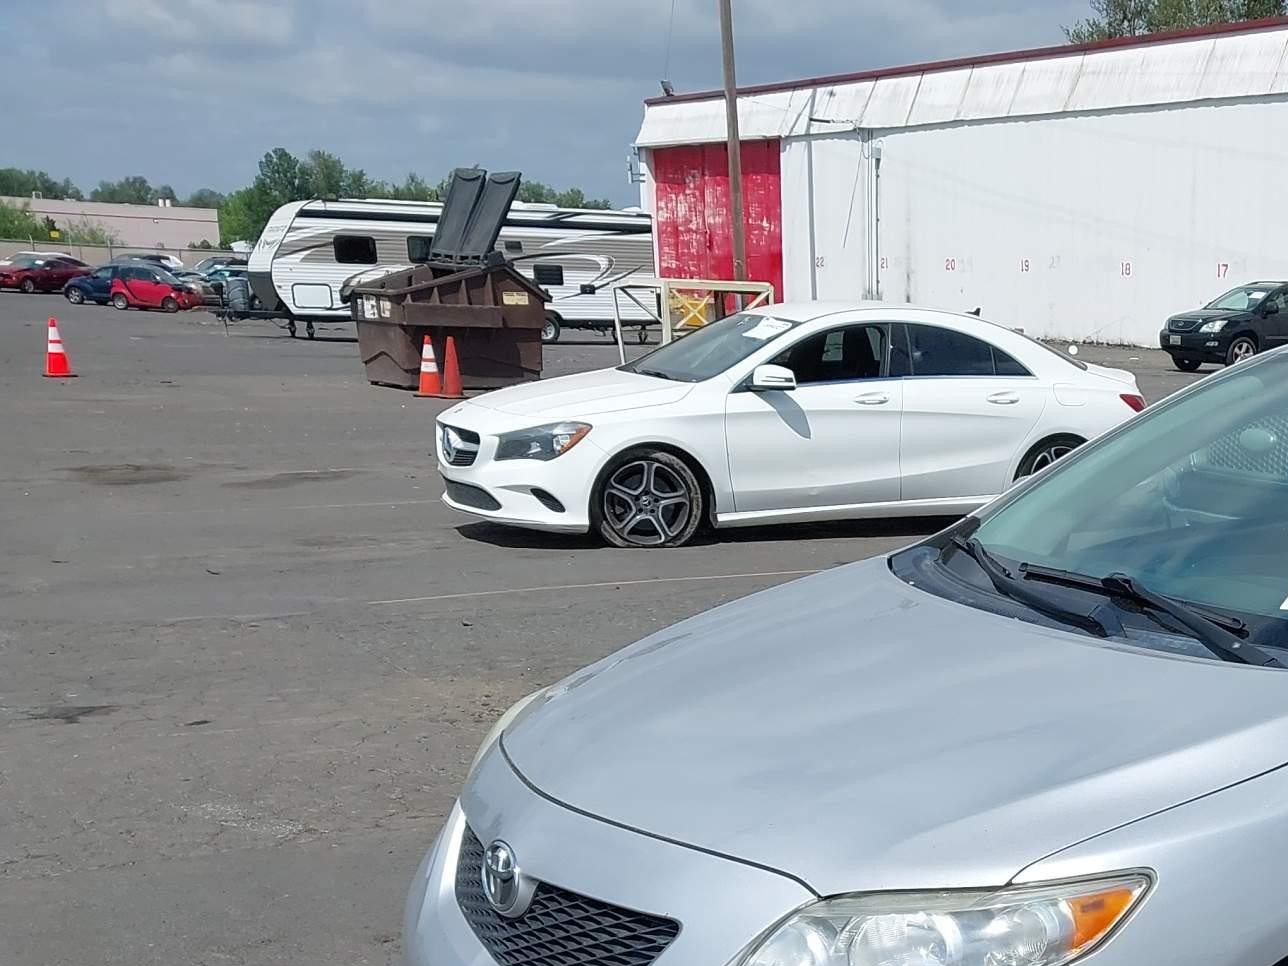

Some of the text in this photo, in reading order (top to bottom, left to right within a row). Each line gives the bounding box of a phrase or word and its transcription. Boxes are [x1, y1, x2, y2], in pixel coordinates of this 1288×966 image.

[815, 256, 825, 268] 22
[880, 257, 889, 269] 21
[945, 258, 956, 271] 20
[1020, 259, 1030, 273] 19
[1121, 262, 1131, 276] 18
[1216, 263, 1229, 278] 17
